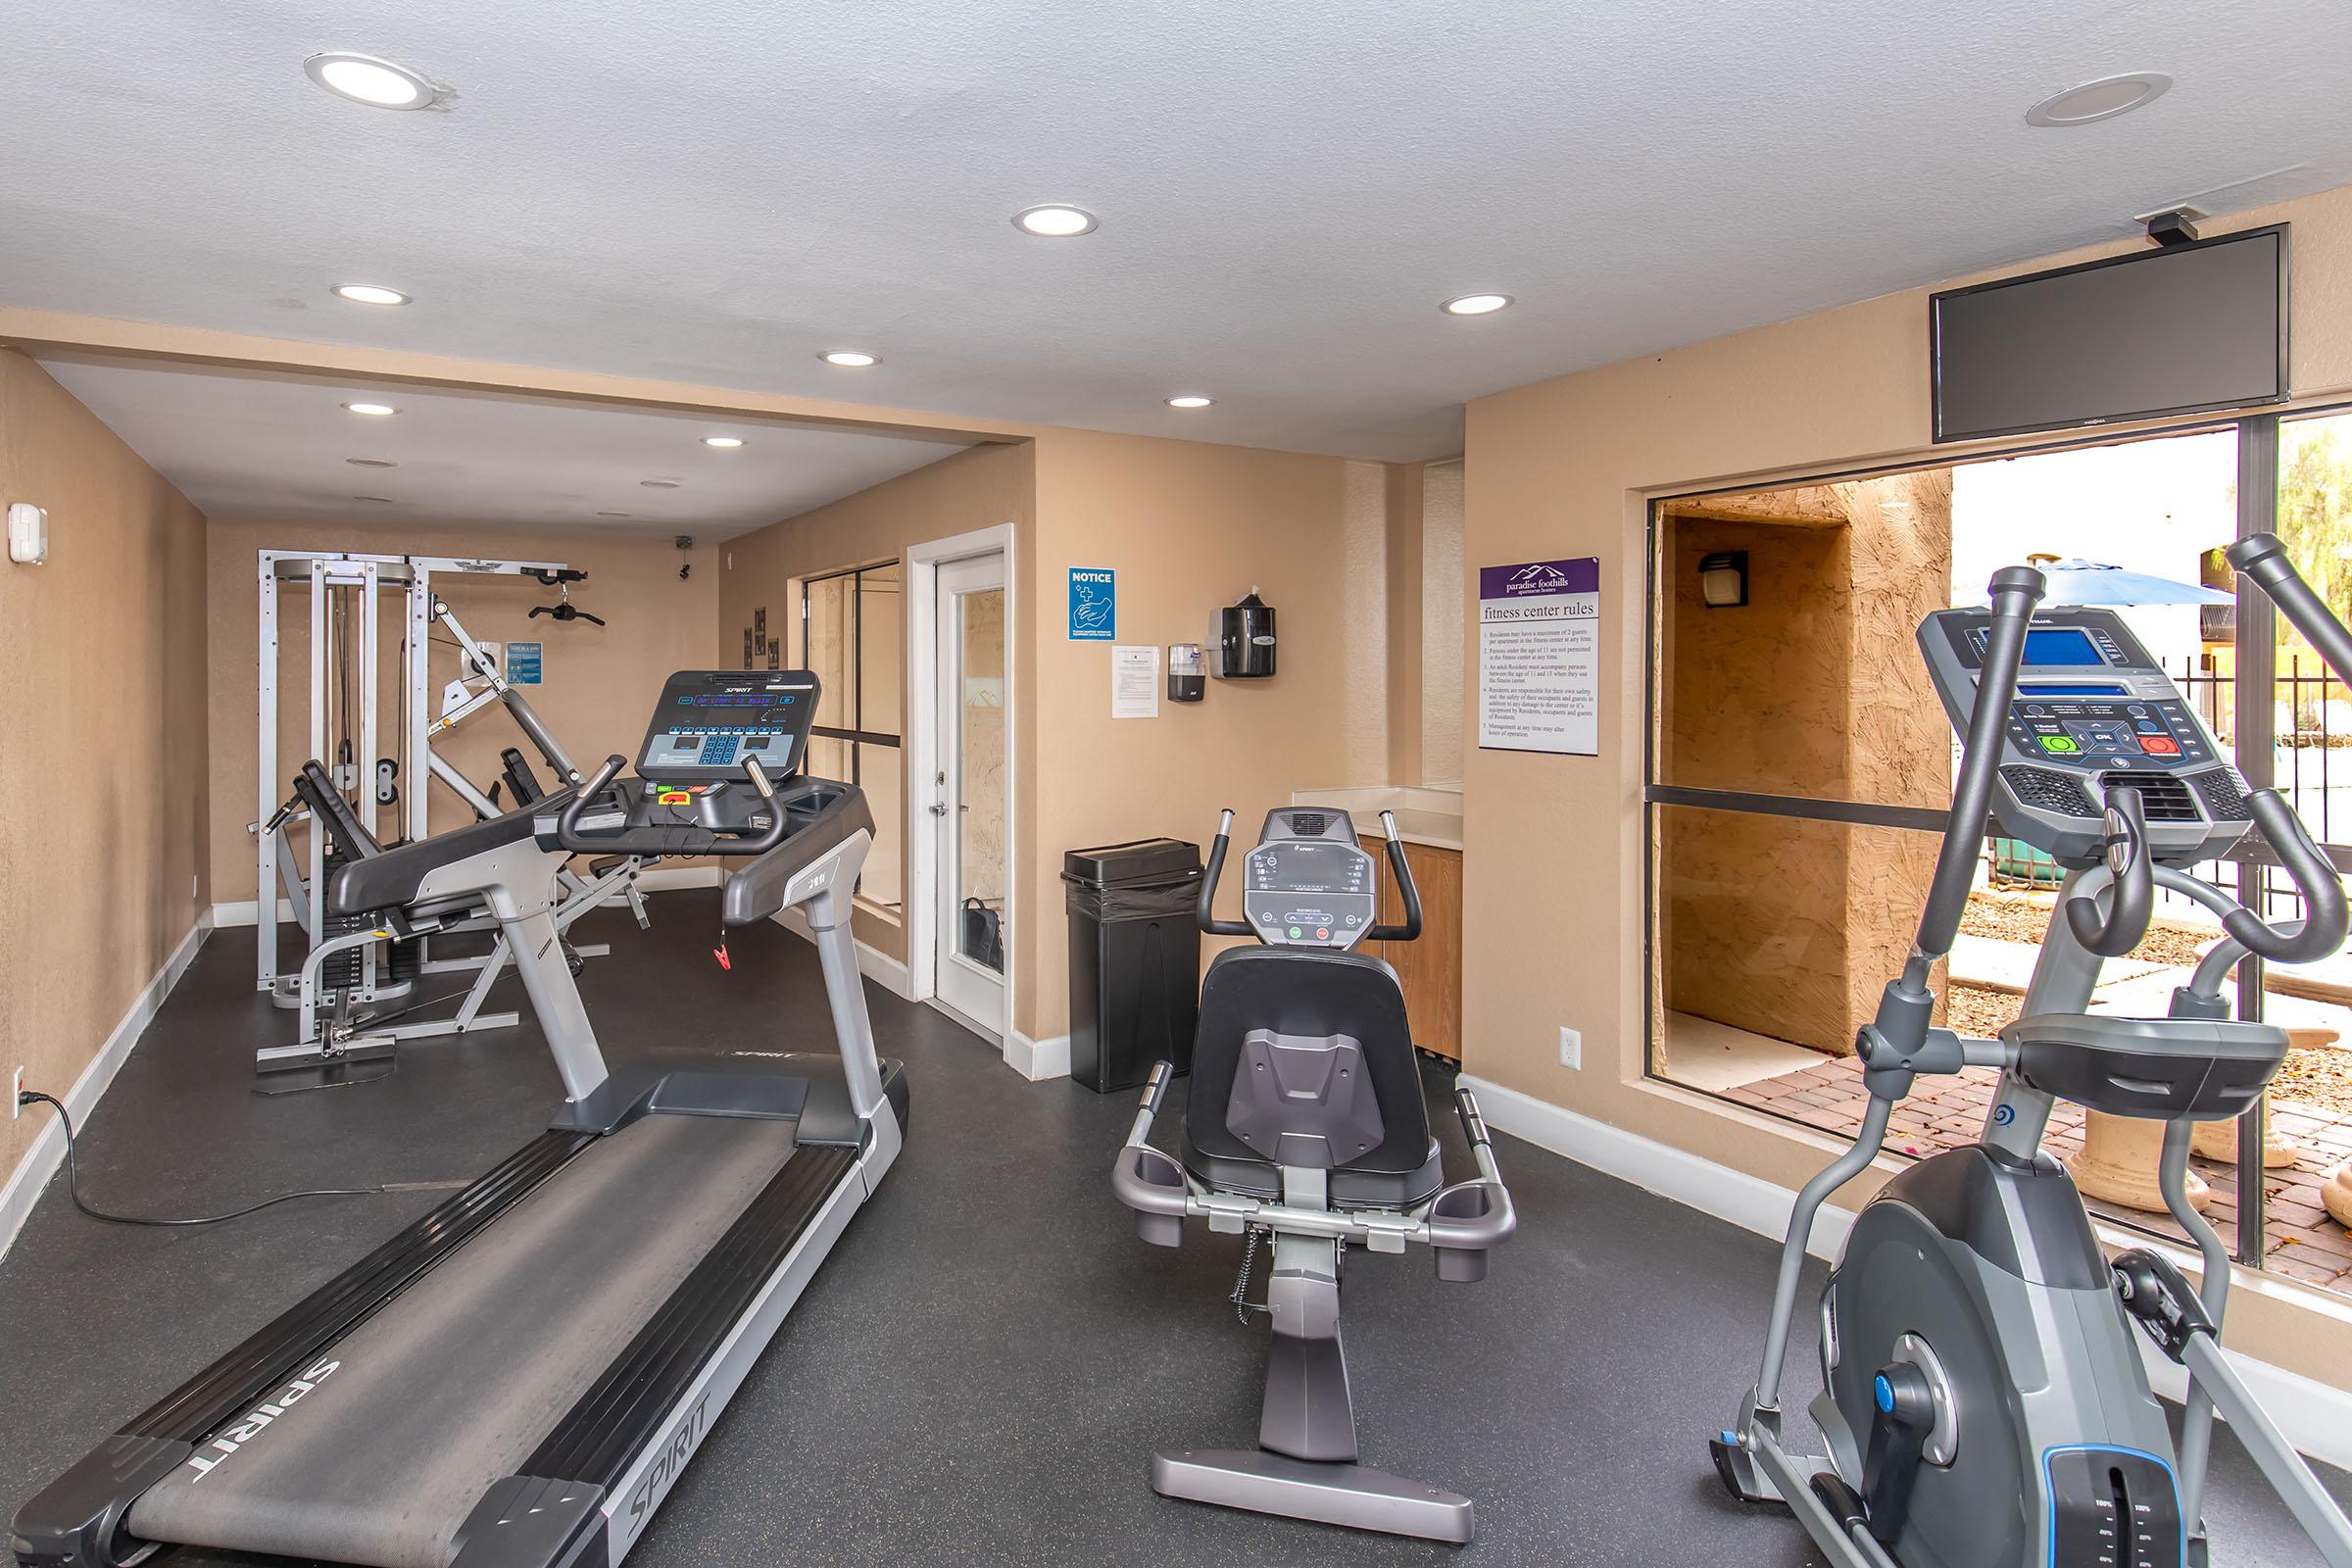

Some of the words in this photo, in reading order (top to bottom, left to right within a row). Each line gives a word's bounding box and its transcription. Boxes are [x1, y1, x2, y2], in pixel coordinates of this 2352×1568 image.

[1072, 572, 1111, 583] NOTICE
[1507, 580, 1537, 593] paradise
[1539, 578, 1568, 589] foothills
[1485, 608, 1519, 619] fitness
[1524, 606, 1560, 616] center
[1564, 602, 1593, 615] rules
[187, 1357, 341, 1484] SPIRIT
[627, 1391, 711, 1541] SPIRIT
[2095, 1499, 2113, 1508] 100%
